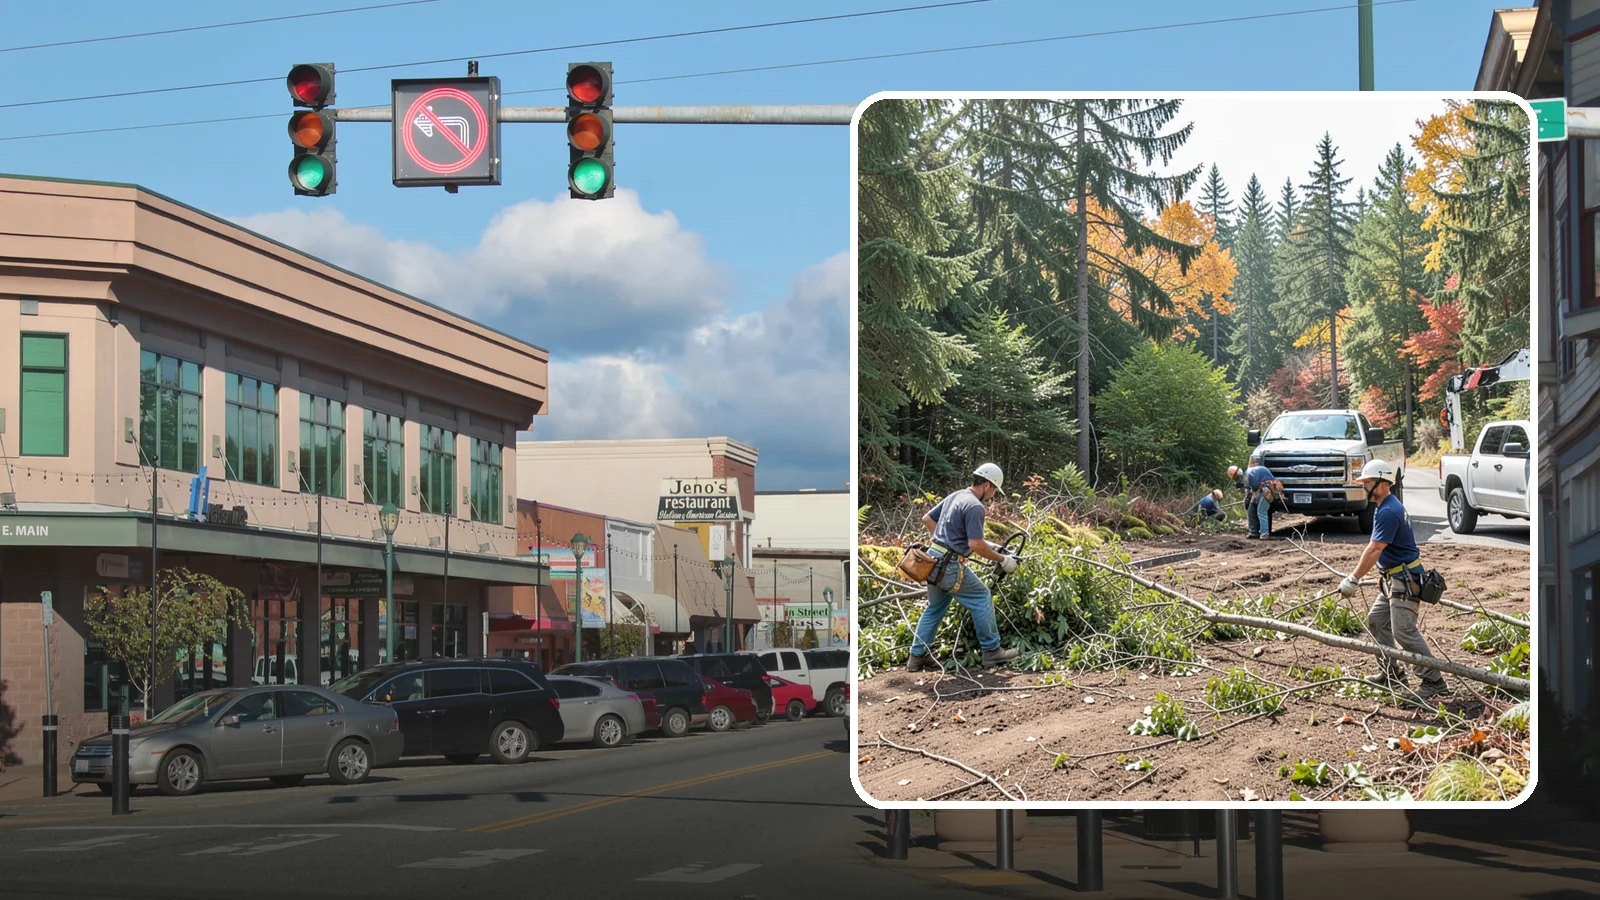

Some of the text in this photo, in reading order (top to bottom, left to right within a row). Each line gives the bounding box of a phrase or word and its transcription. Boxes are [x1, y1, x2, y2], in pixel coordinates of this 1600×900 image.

[669, 480, 728, 495] Jeno's
[665, 496, 731, 509] restaurant
[658, 510, 682, 520] Italian
[686, 510, 714, 519] American
[714, 510, 737, 519] Cuisine
[2, 525, 49, 536] E. MAIN
[797, 607, 828, 617] Street
[791, 619, 823, 627] lass
